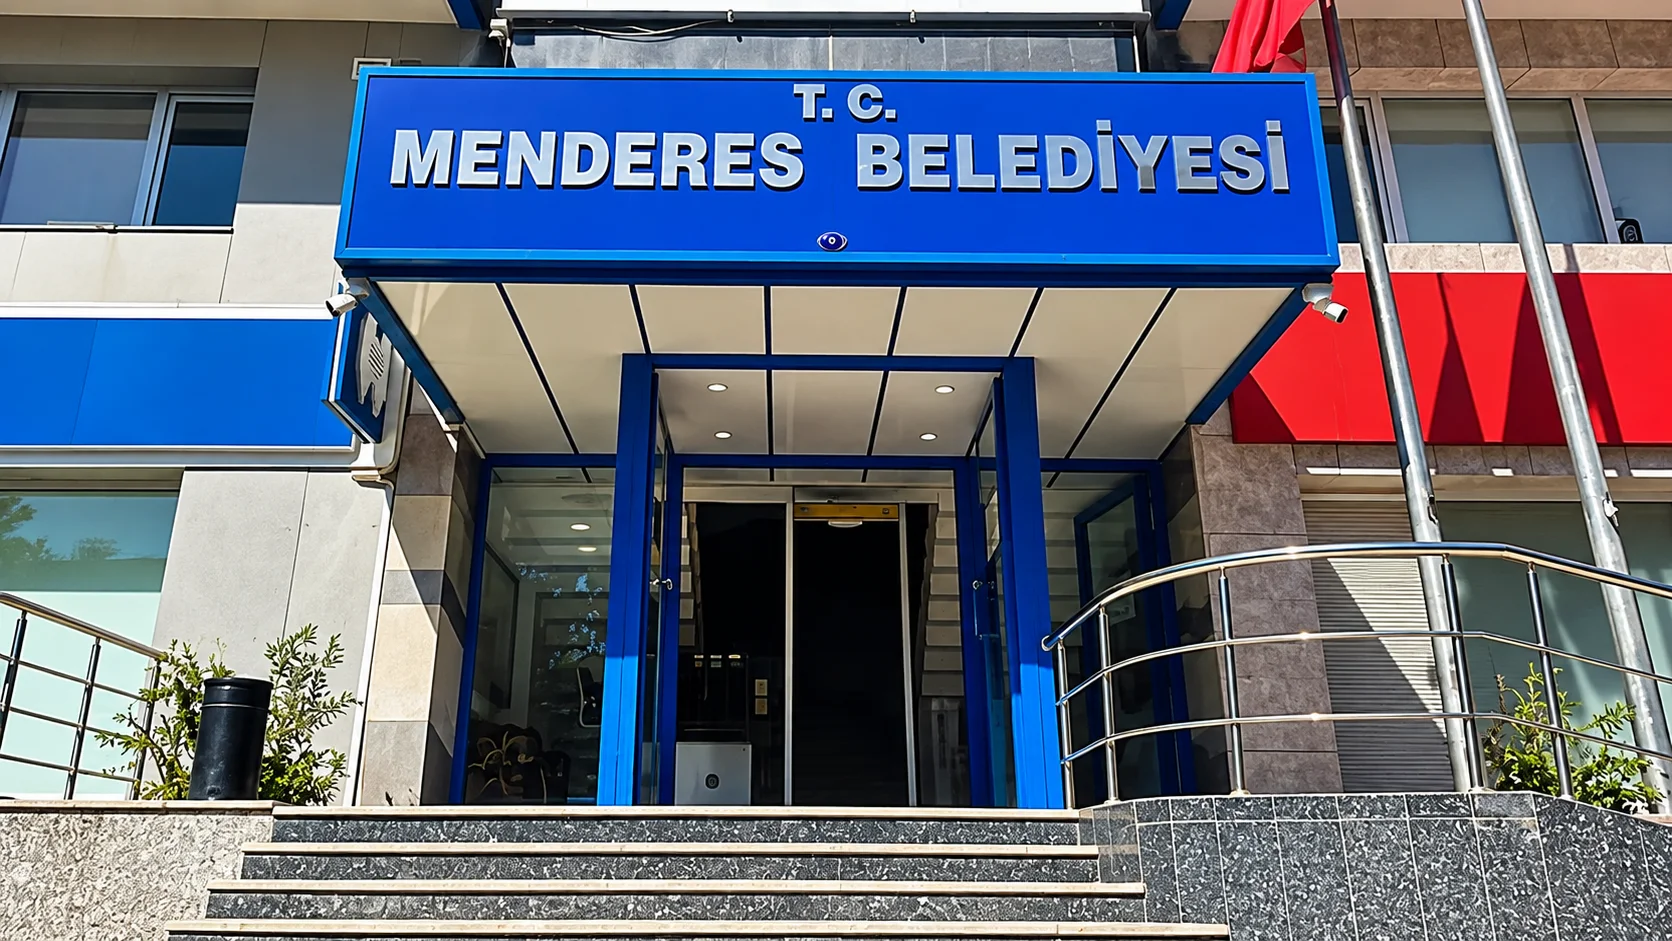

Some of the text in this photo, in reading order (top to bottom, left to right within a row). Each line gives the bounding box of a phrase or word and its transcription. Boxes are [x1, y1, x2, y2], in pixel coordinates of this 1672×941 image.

[793, 83, 897, 121] T. C.
[390, 119, 1291, 192] MENDERES BELEDİYESİ
